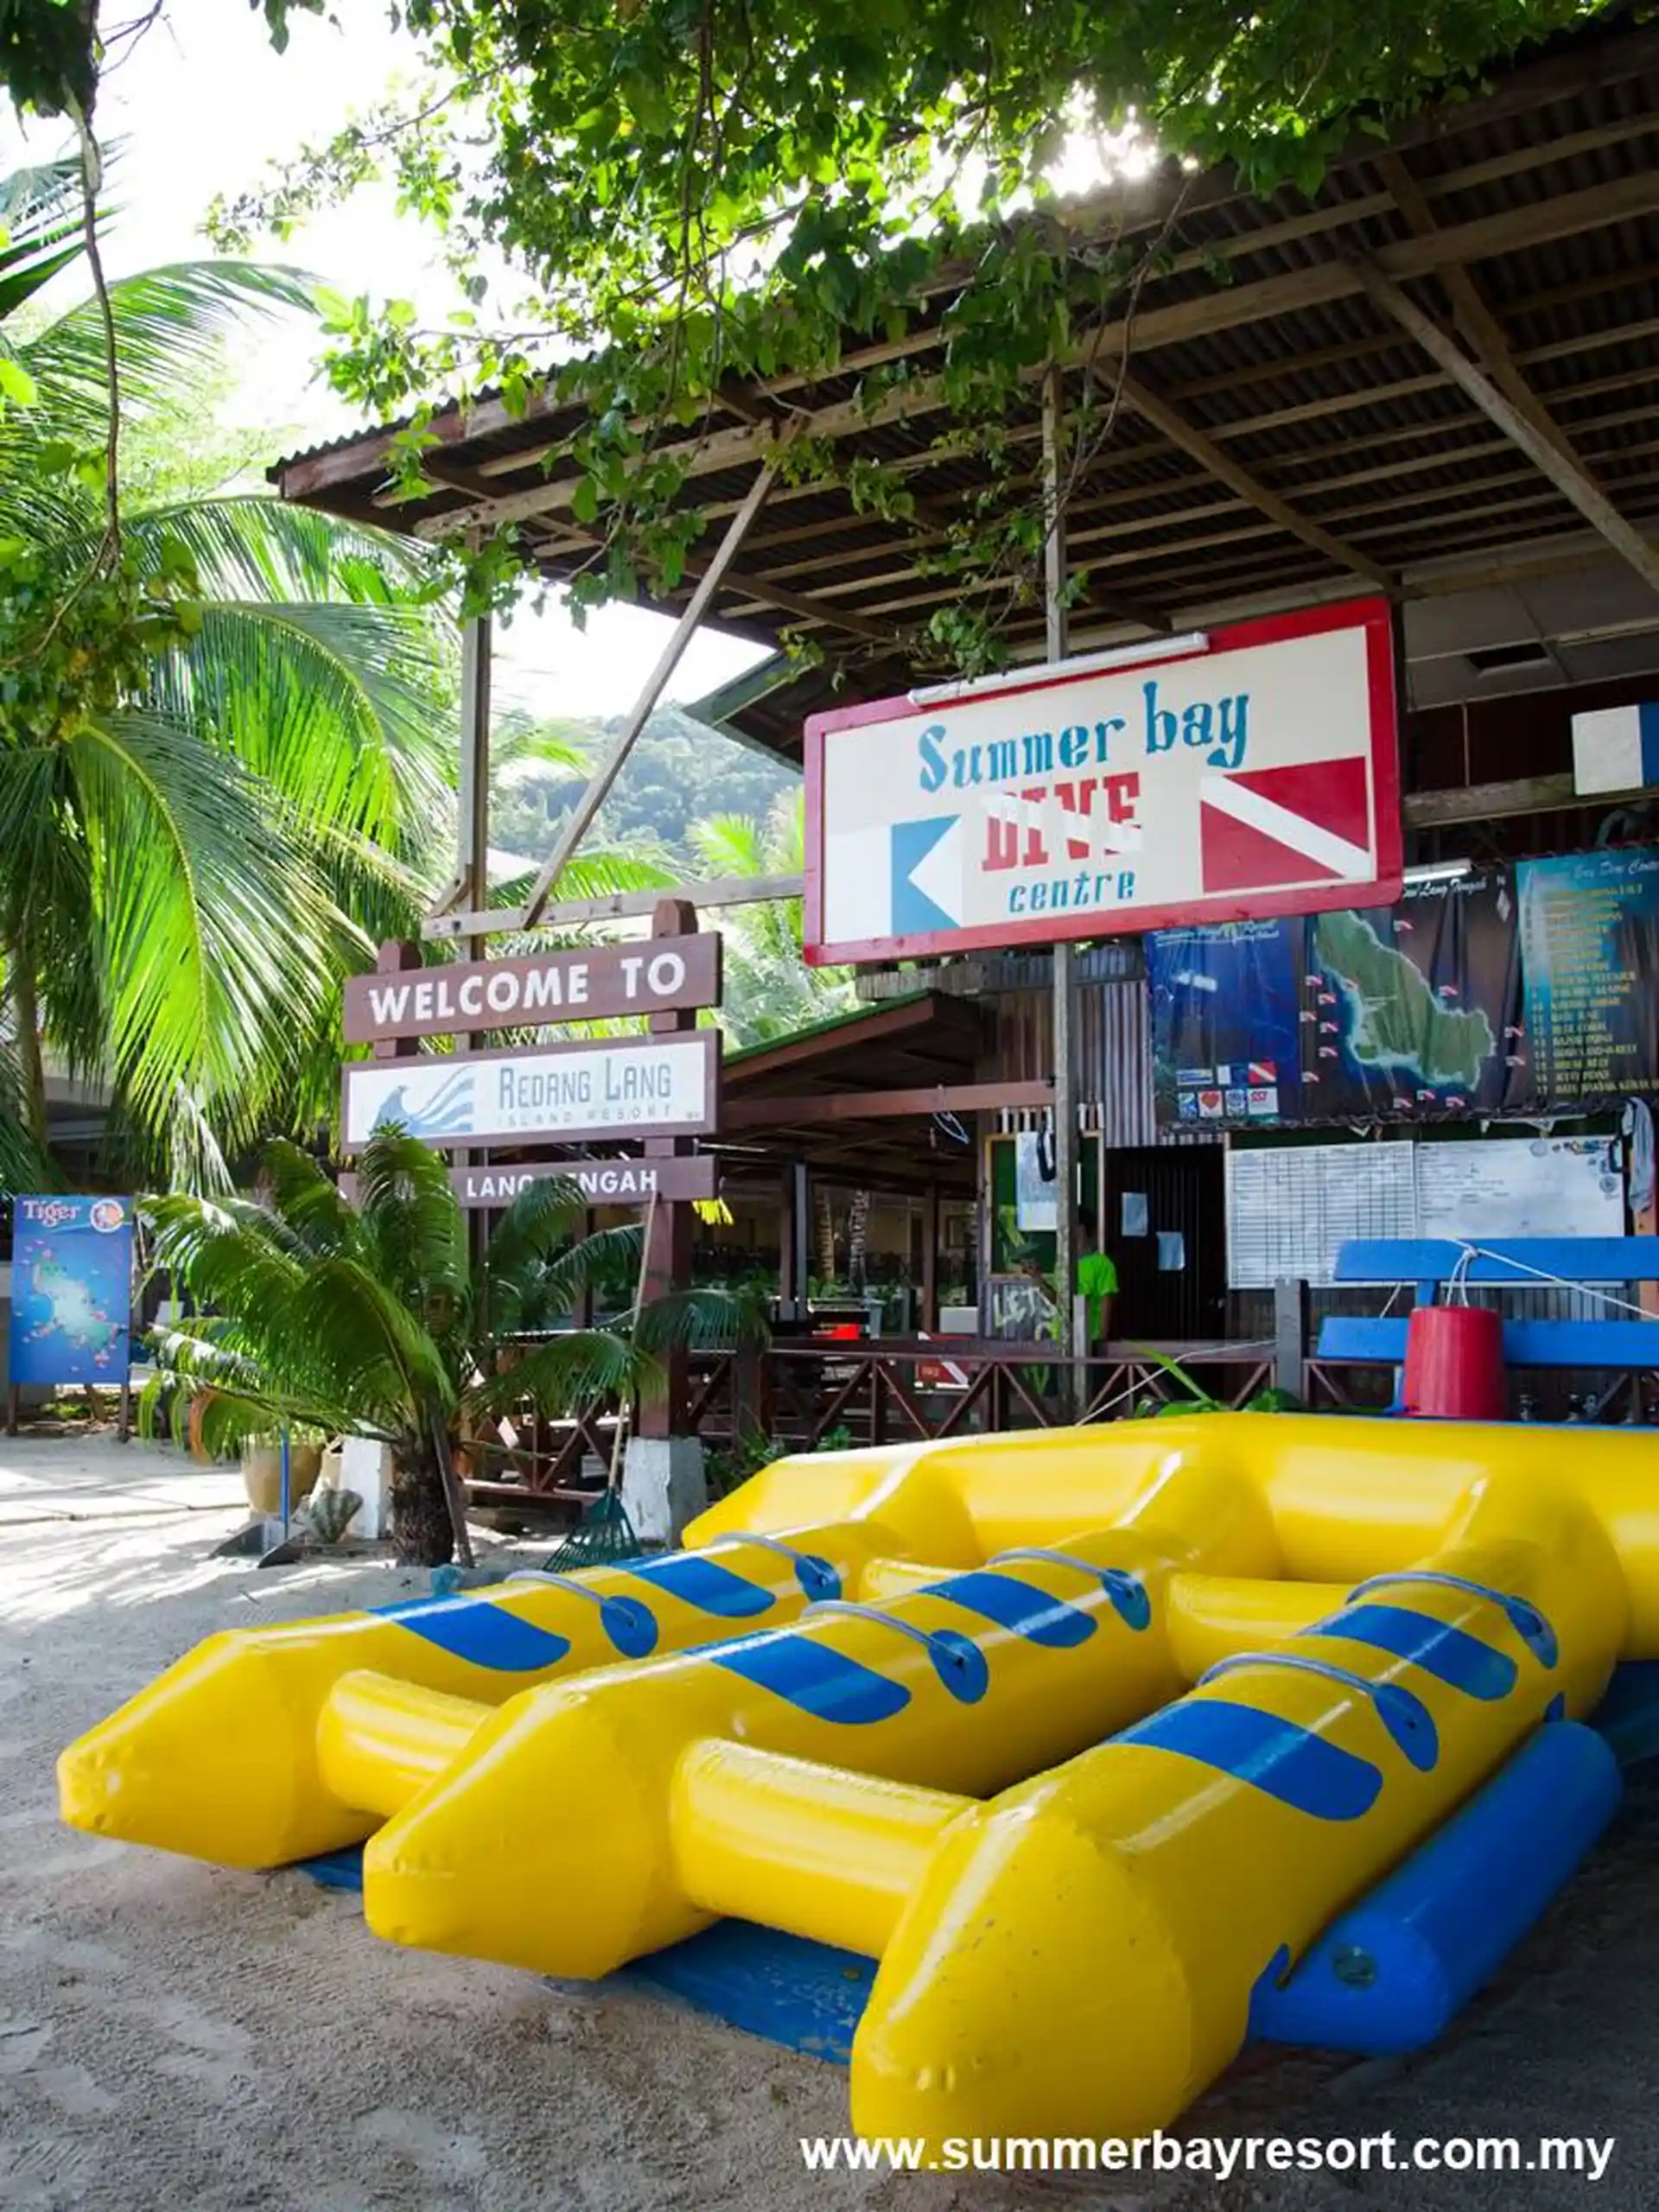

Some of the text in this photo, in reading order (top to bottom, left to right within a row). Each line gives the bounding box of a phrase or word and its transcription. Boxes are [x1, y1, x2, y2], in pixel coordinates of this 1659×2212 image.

[918, 681, 1249, 792] Summer bay
[982, 772, 1142, 872] DIVE
[1009, 869, 1135, 913] centre
[368, 952, 686, 1025] WELCOME TO
[499, 1057, 672, 1110] REDANG LANG
[543, 1169, 658, 1195] NGAH
[22, 1198, 82, 1228] Tiger
